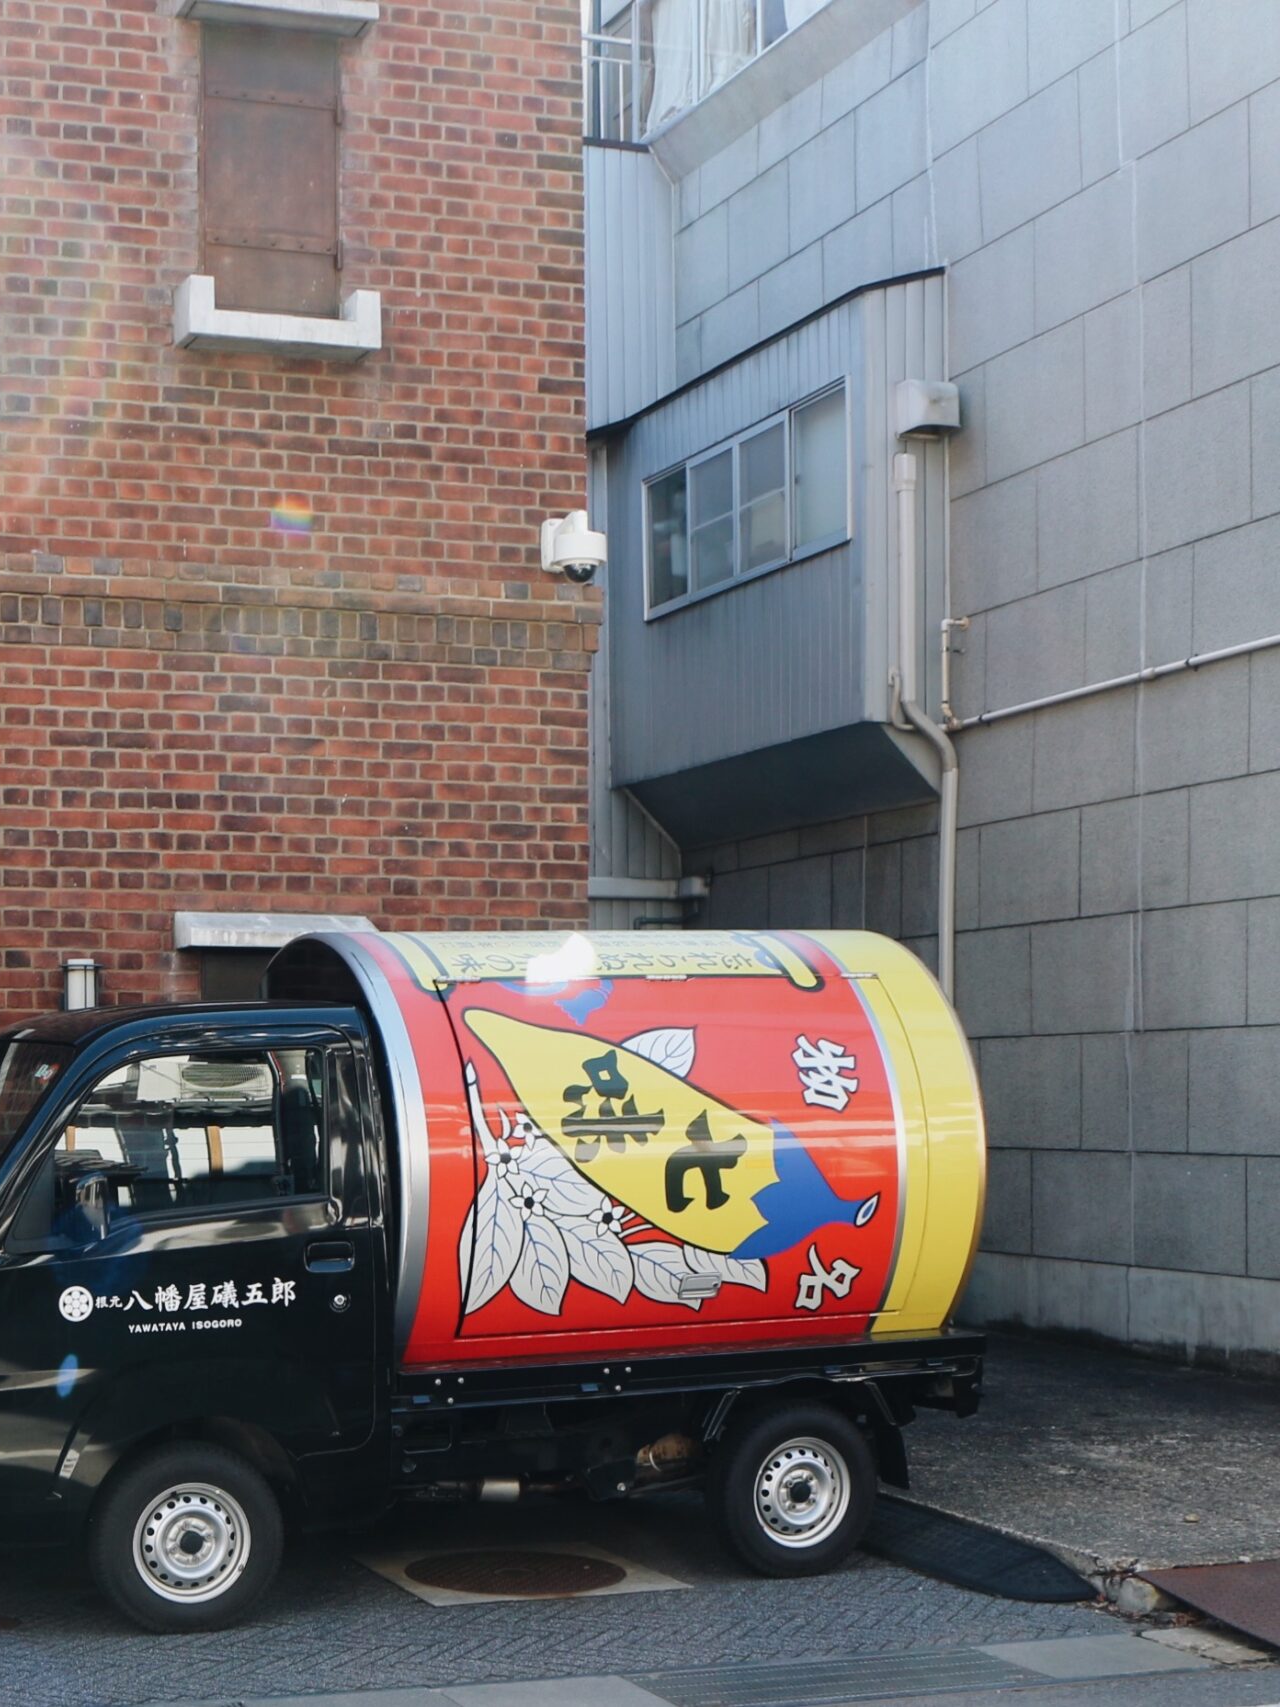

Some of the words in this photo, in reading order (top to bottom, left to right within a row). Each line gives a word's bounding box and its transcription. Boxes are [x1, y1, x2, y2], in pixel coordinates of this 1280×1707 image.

[451, 952, 753, 973] 忘れられぬの味
[792, 1034, 860, 1113] 物
[560, 1049, 748, 1213] 七味
[794, 1244, 863, 1313] 名
[128, 1321, 186, 1334] YAWATAYA
[191, 1318, 243, 1330] ISOGORO
